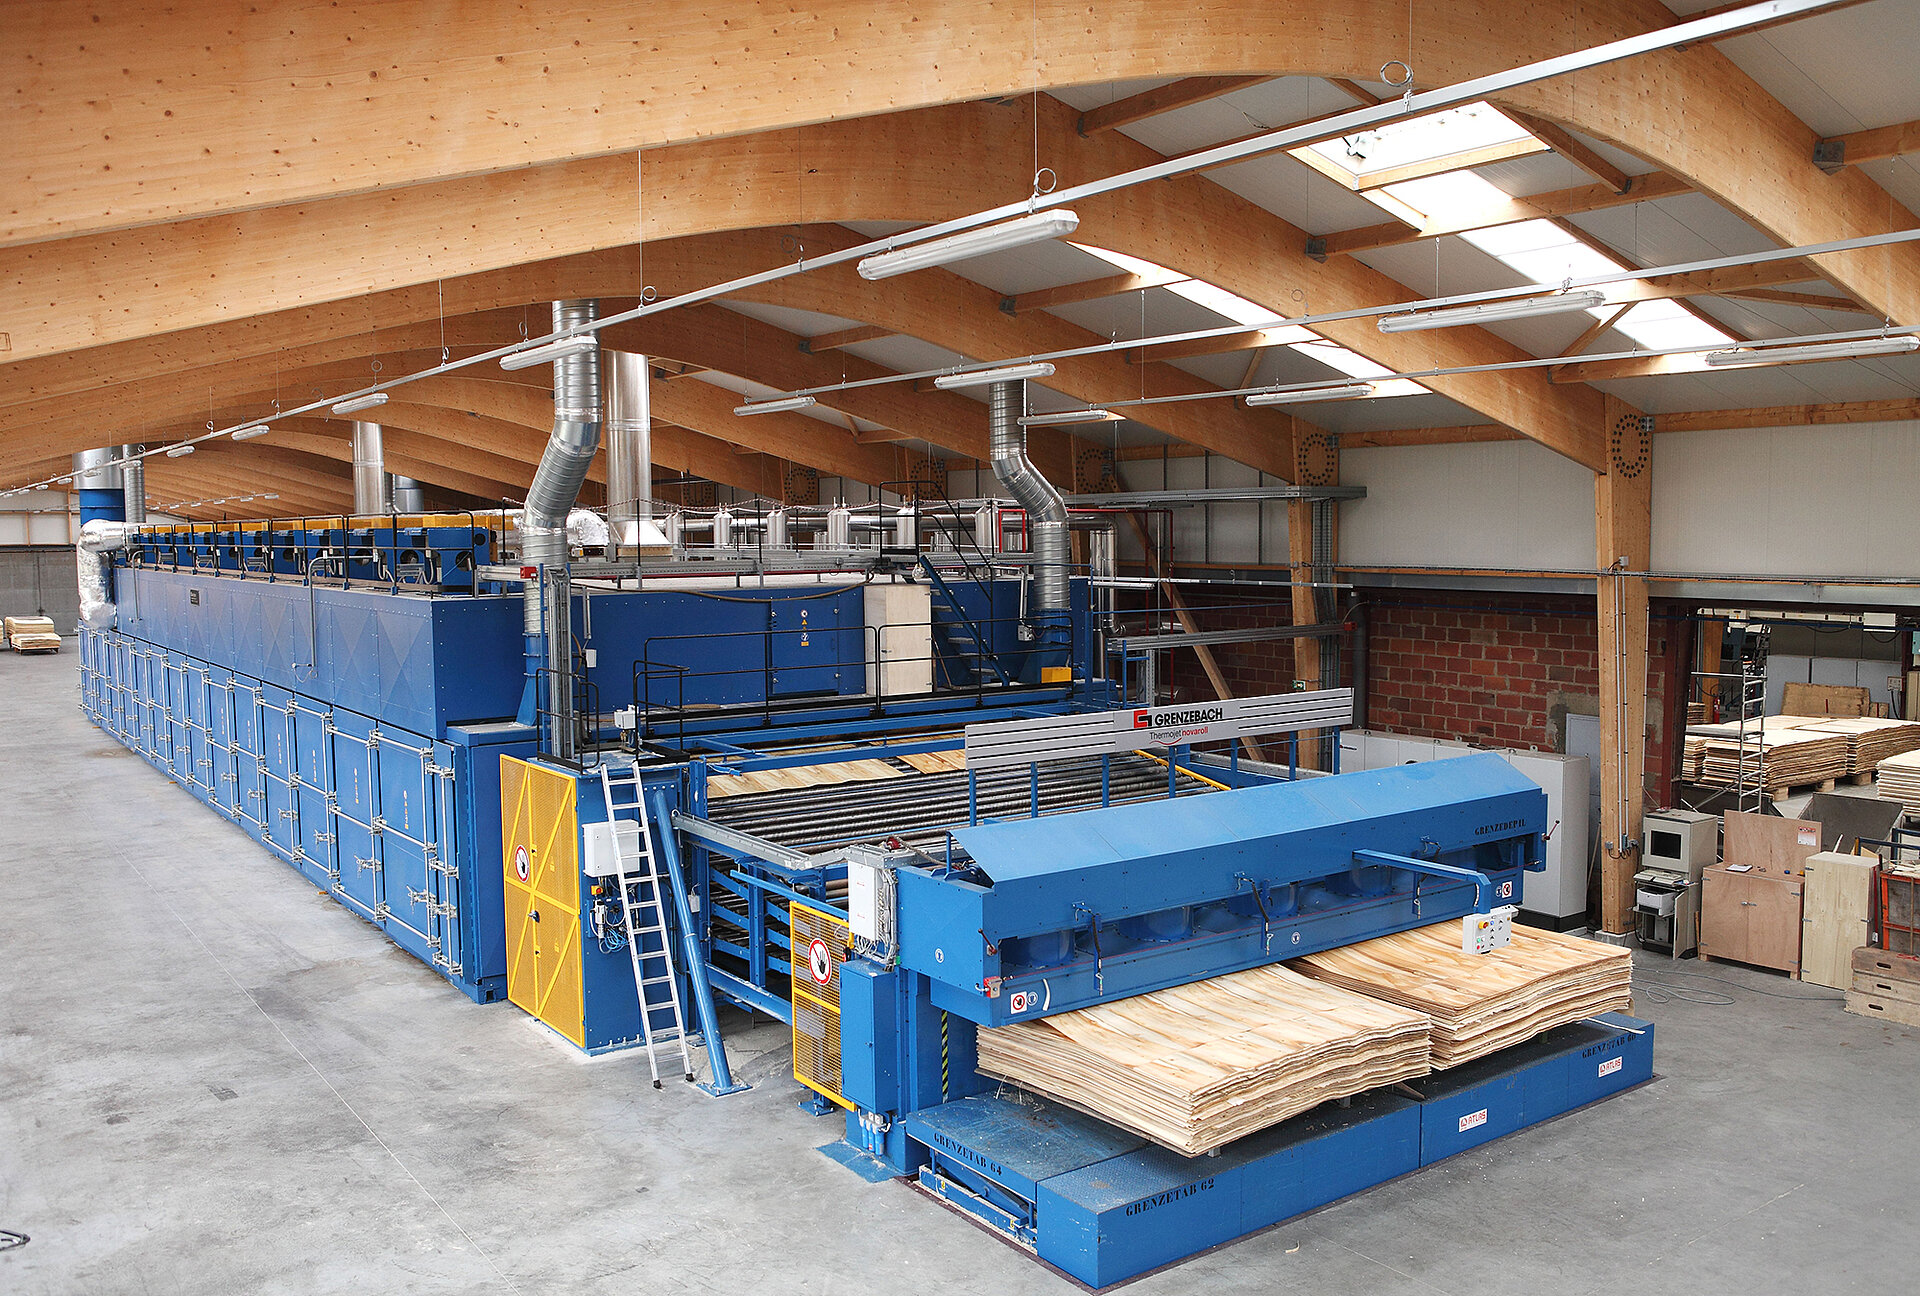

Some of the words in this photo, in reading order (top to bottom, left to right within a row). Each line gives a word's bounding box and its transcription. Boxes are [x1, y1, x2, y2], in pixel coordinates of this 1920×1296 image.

[1155, 708, 1223, 726] GRENZEBACH
[1149, 730, 1181, 740] Thermojet
[1182, 726, 1208, 736] novaroll
[1474, 819, 1527, 835] GRENZEDEPIL
[1582, 1036, 1625, 1058] GRENZETAB
[1606, 1058, 1621, 1070] ATLAS
[1468, 1111, 1486, 1125] ATLAS
[934, 1133, 987, 1168] GRENZETAB
[990, 1162, 1002, 1176] 64
[1125, 1184, 1197, 1217] GRENZETAB
[1200, 1178, 1215, 1191] 62
